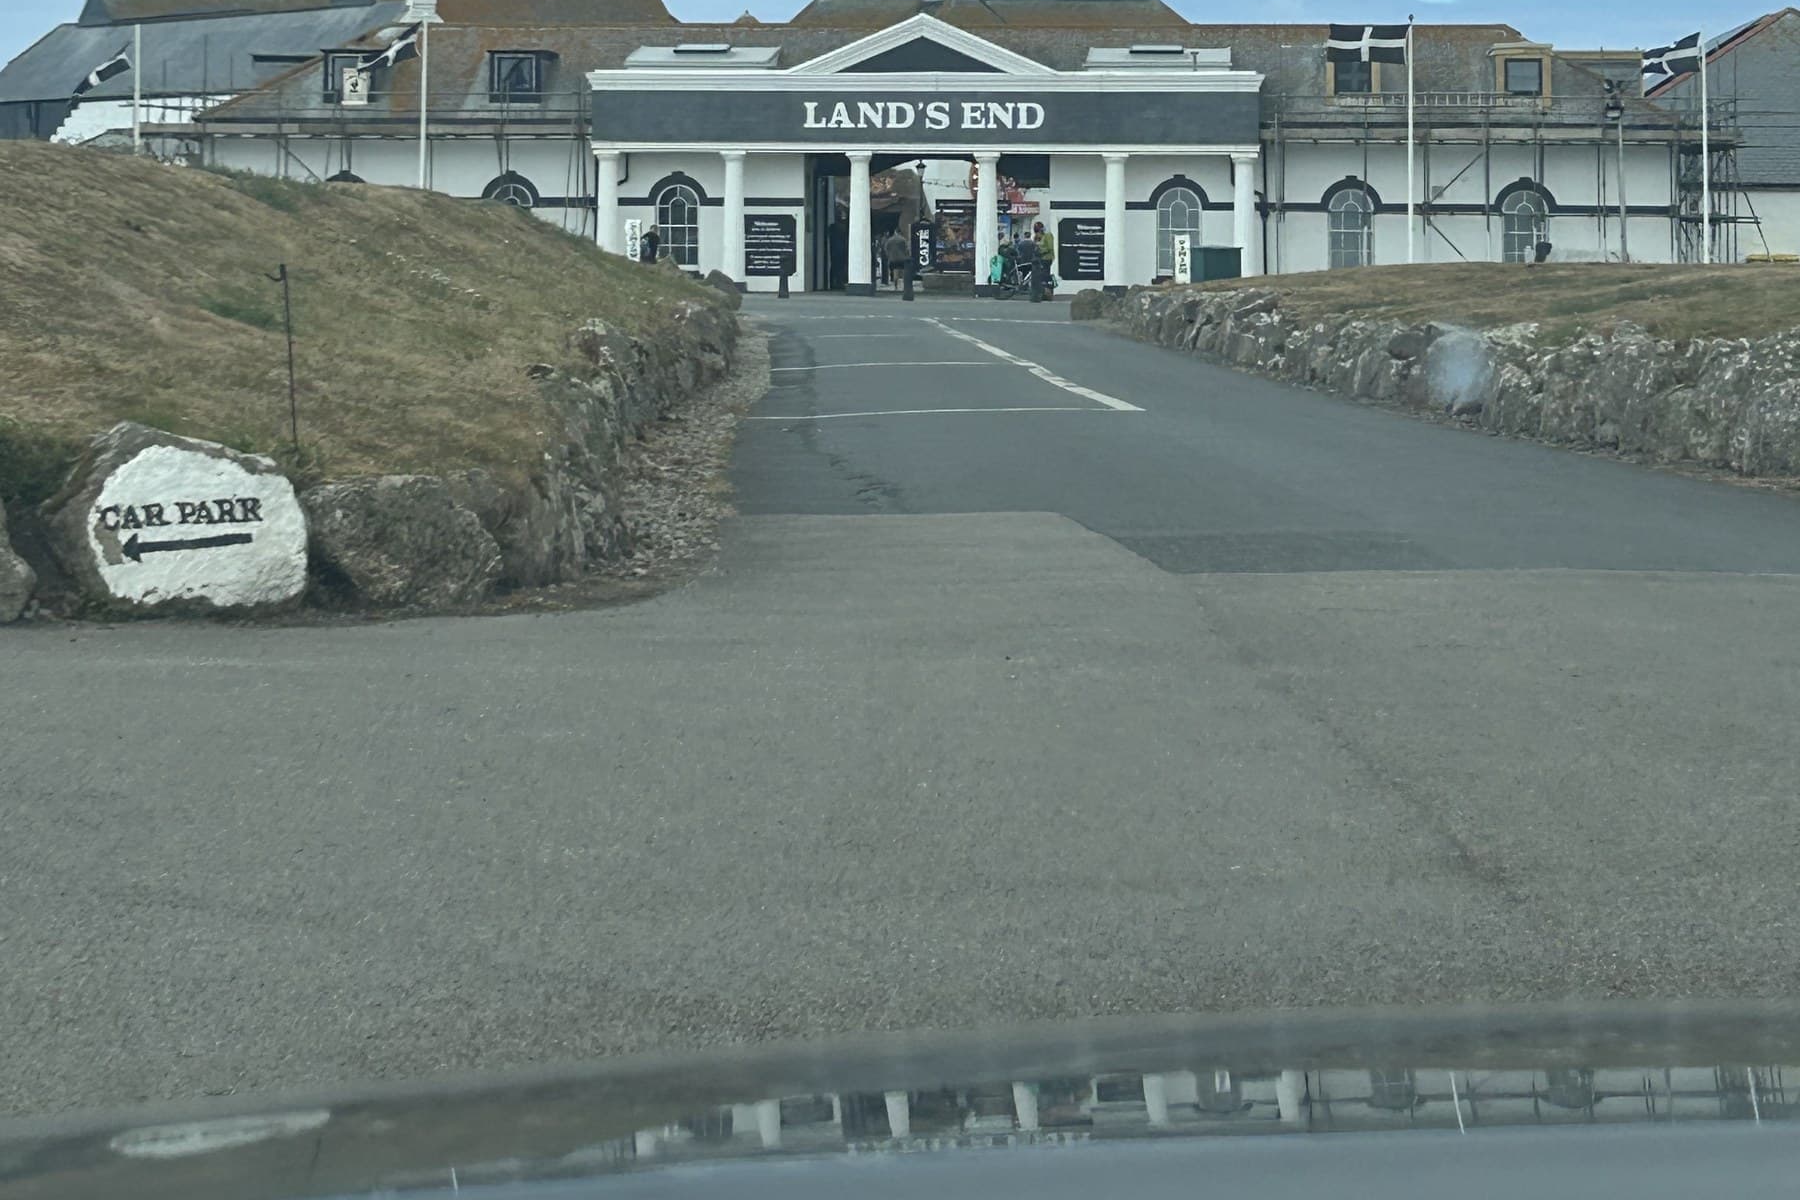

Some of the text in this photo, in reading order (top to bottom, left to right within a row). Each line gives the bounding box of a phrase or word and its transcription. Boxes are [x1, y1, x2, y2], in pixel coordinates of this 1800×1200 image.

[803, 101, 1045, 129] LAND'S END
[915, 229, 930, 266] CAFÉ
[98, 497, 263, 531] CAR PARK
